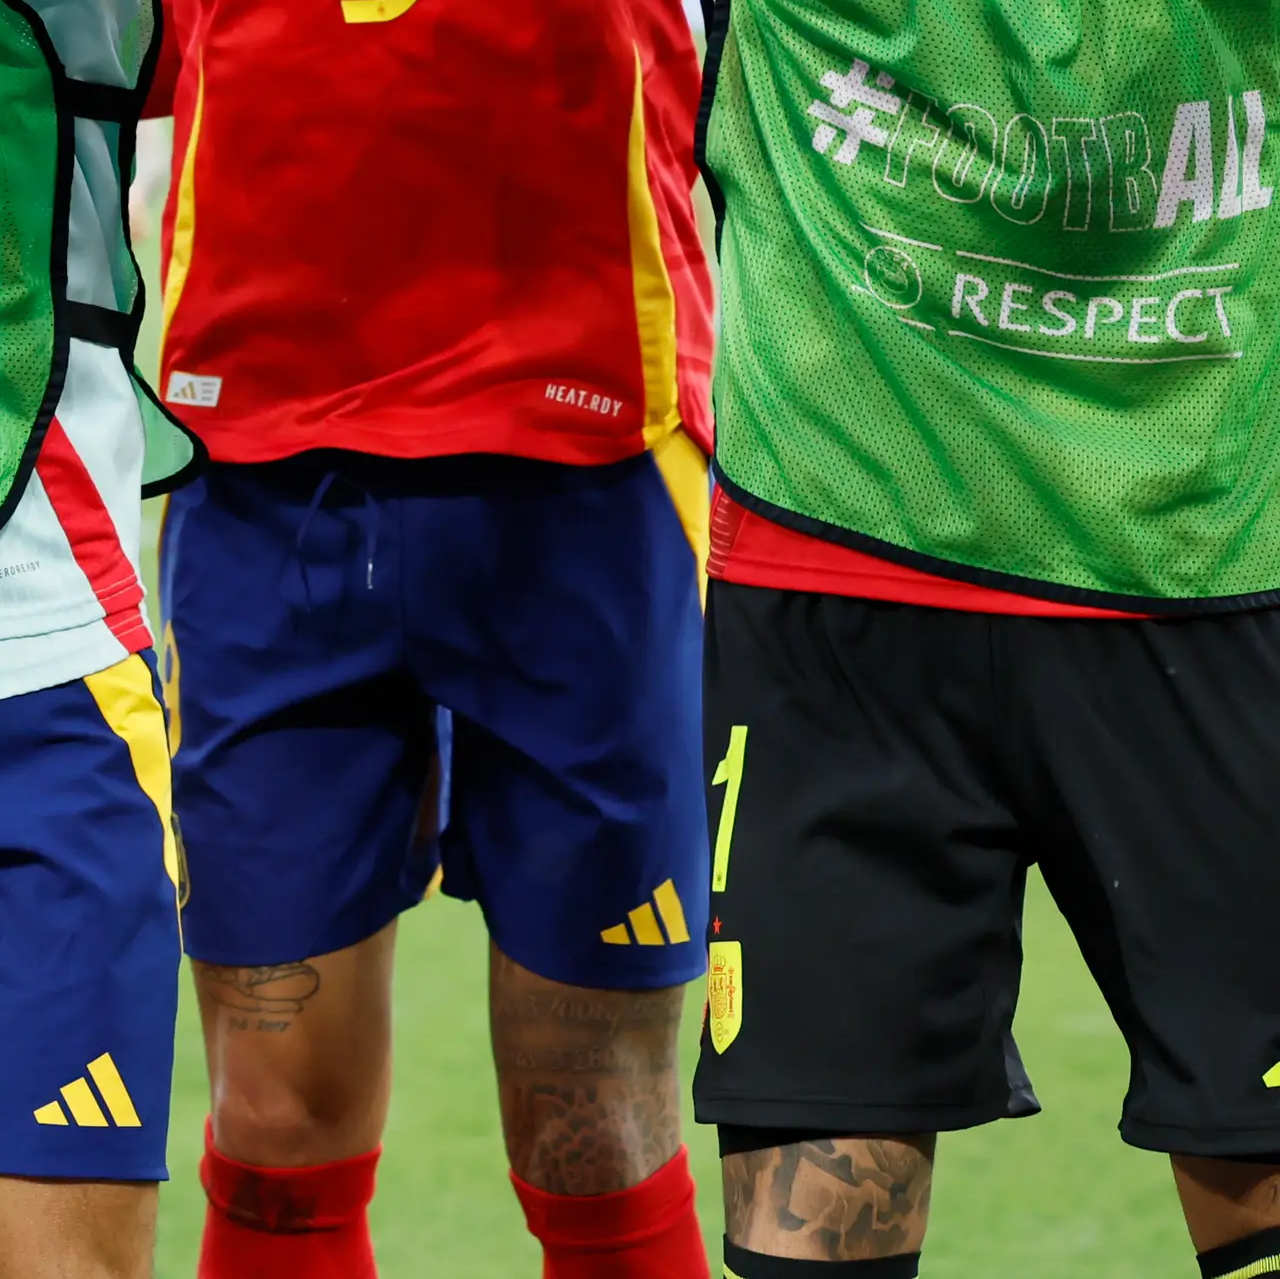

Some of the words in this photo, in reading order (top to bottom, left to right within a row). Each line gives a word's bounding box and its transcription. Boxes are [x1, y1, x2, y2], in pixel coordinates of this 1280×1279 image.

[806, 58, 1274, 233] #FOOTBALL
[951, 272, 1234, 344] RESPECT
[545, 383, 623, 417] HEAT.RDY
[711, 724, 749, 893] 1
